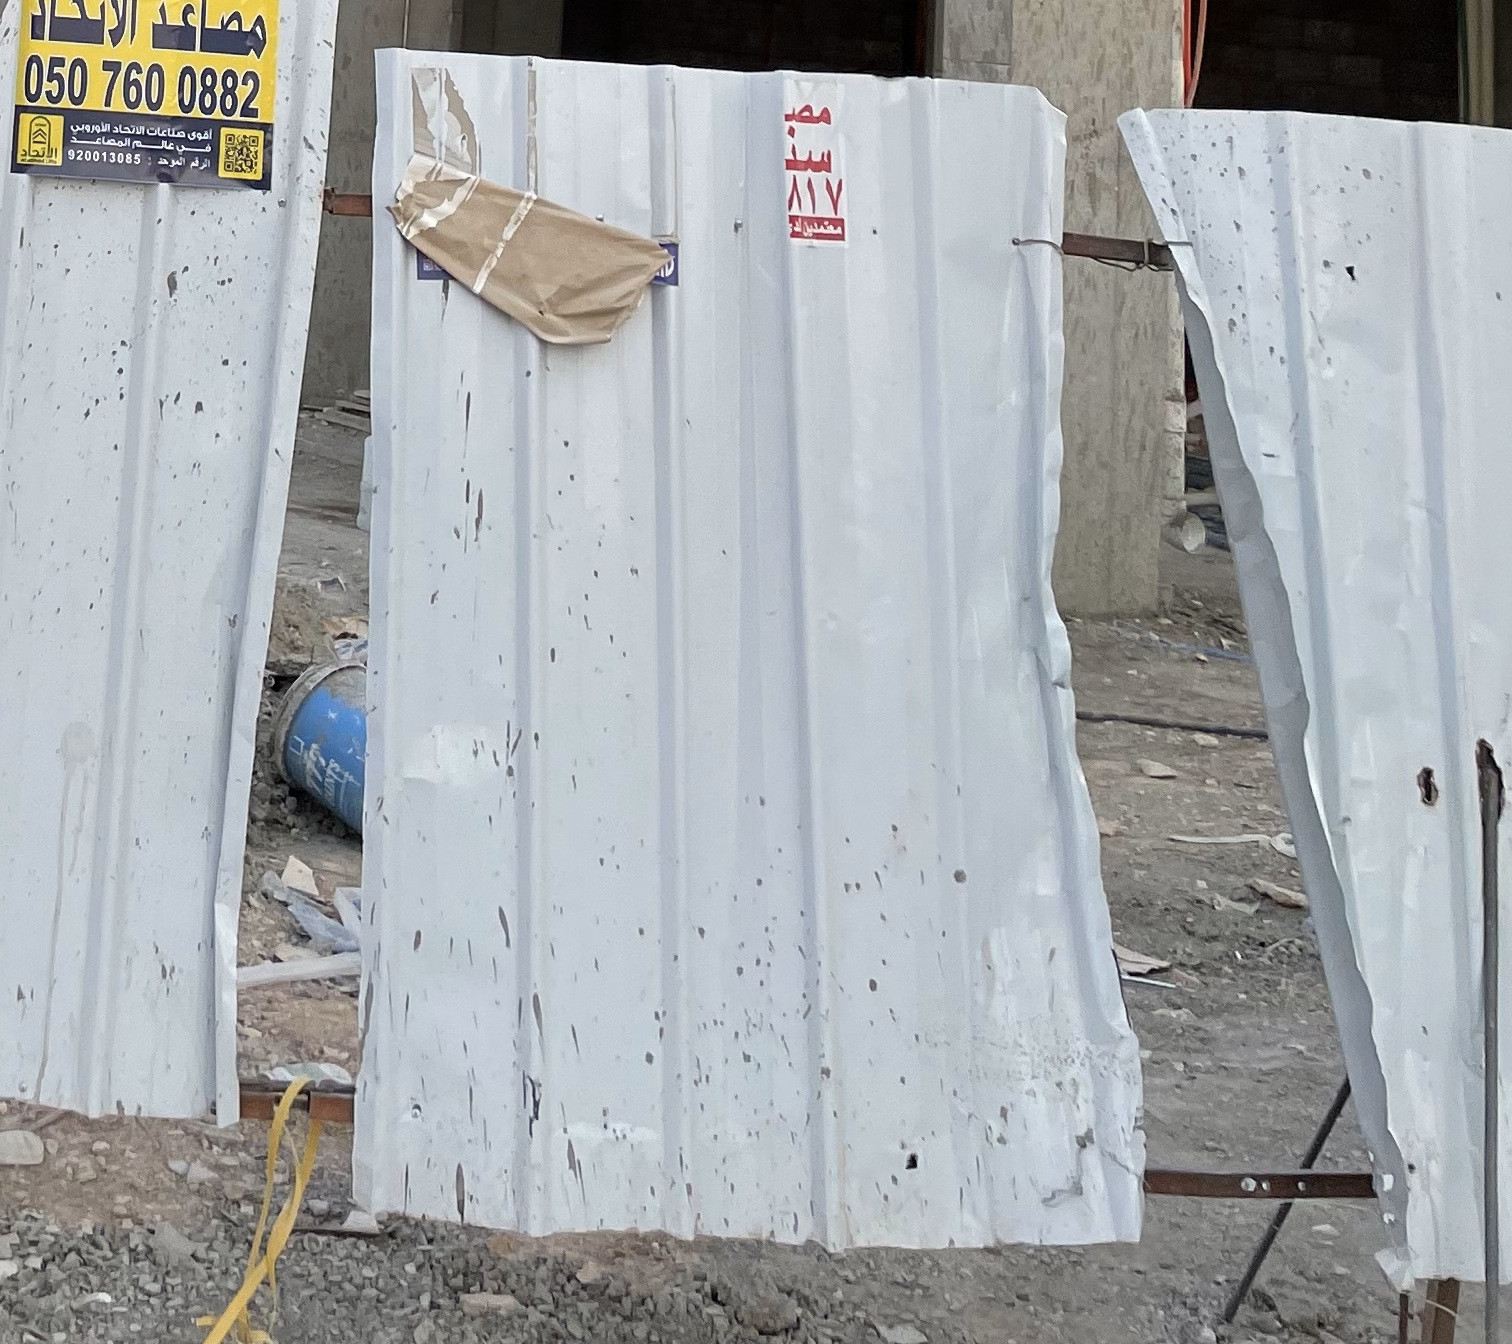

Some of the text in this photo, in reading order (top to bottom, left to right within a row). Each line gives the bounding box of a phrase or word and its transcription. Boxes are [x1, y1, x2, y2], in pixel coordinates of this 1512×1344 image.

[24, 54, 260, 118] 050 760 0882
[113, 123, 145, 136] الاتحاد
[146, 125, 186, 140] صناعات
[70, 135, 131, 148] المصاعد
[67, 148, 141, 165] 920013085
